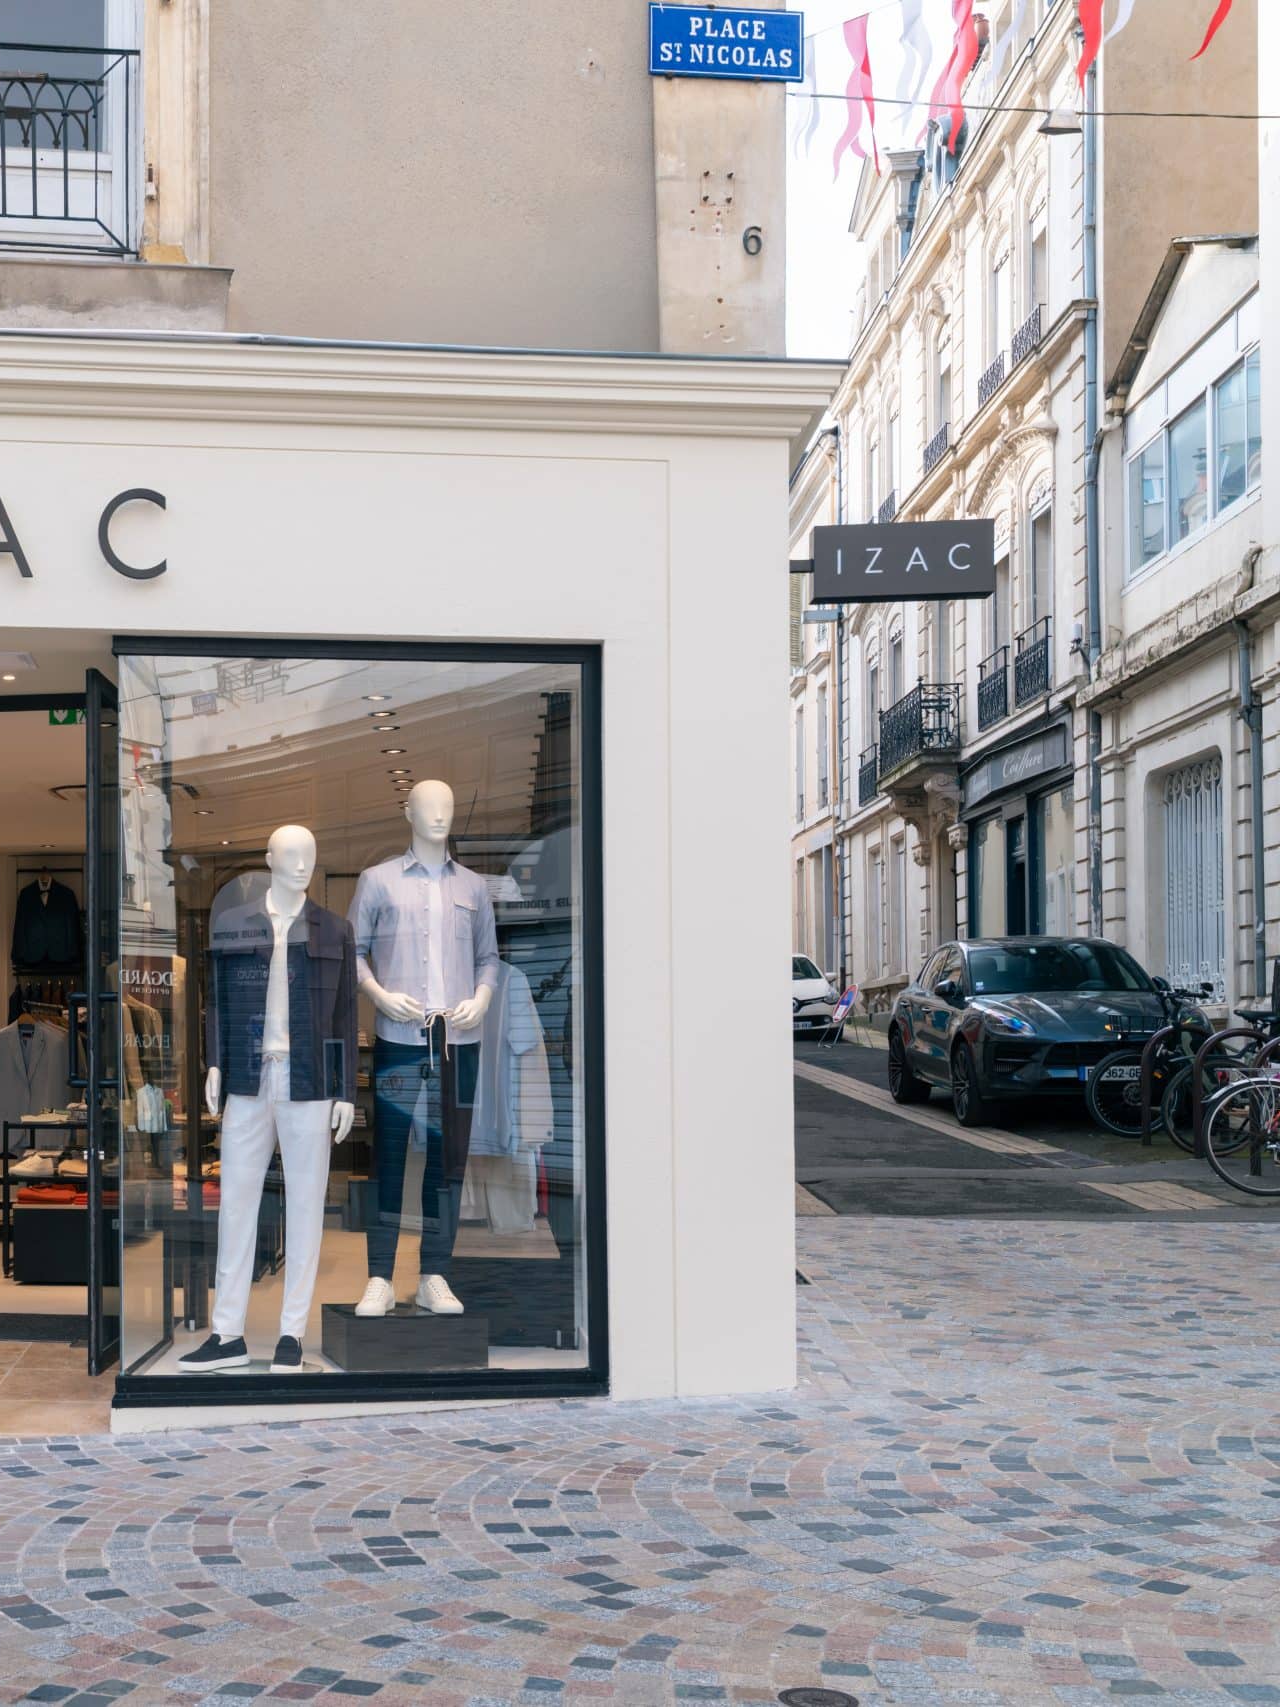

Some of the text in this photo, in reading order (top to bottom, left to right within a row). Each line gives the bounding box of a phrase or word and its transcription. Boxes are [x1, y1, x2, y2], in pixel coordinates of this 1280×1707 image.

[689, 17, 766, 40] PLACE
[689, 44, 793, 68] NICOLAS
[742, 226, 763, 256] 6
[836, 543, 971, 576] IZAC
[1002, 749, 1043, 778] Coiffure
